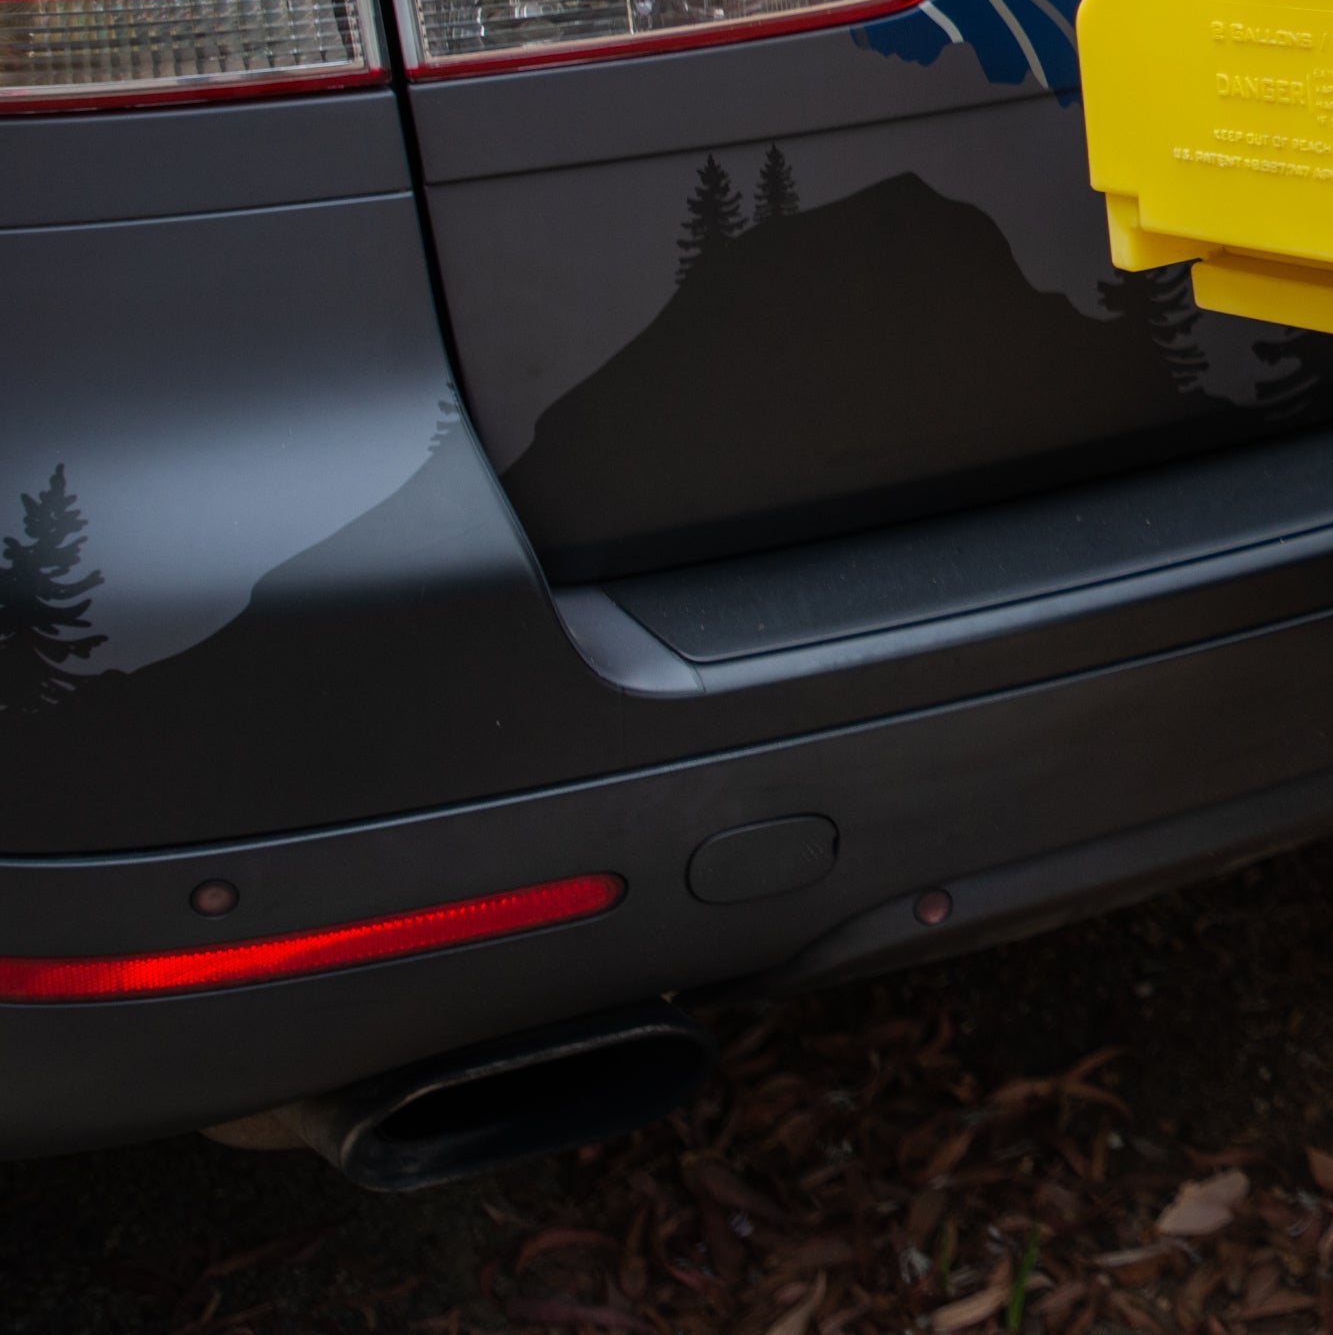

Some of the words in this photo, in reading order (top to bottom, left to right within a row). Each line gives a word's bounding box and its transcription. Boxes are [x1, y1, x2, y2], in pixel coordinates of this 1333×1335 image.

[1209, 19, 1225, 43] 2
[1229, 22, 1314, 51] GALLONS
[1214, 71, 1306, 106] DANGER
[1213, 127, 1244, 143] KEEP
[1246, 131, 1270, 146] OUT
[1271, 134, 1289, 148] OF
[1291, 137, 1332, 154] REACH
[1194, 149, 1243, 168] PATENT
